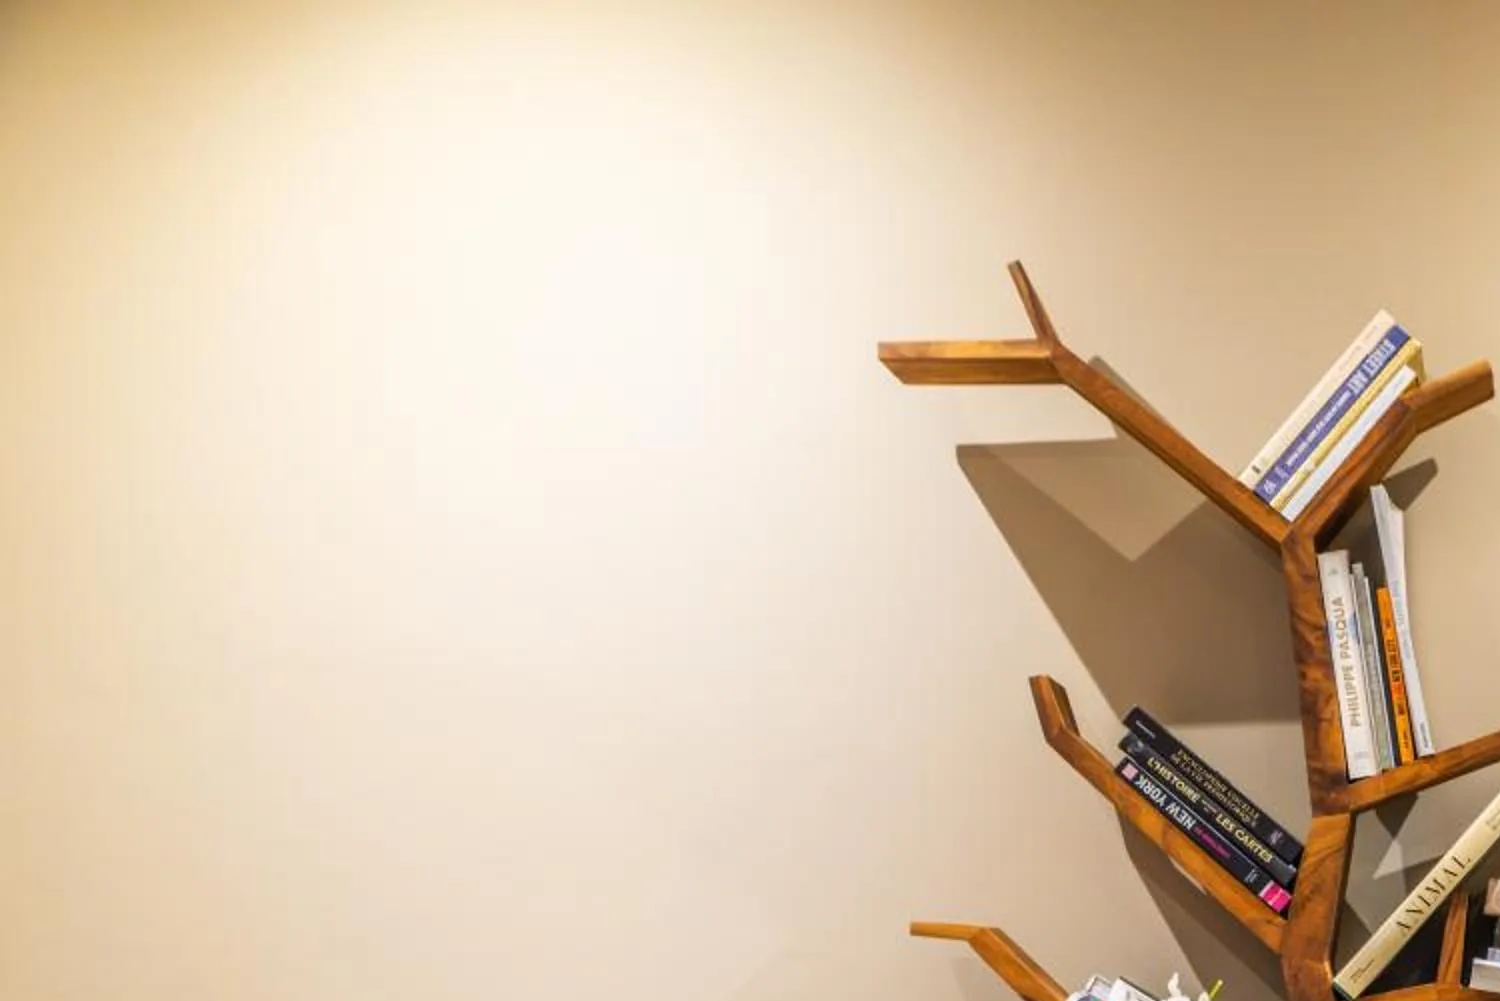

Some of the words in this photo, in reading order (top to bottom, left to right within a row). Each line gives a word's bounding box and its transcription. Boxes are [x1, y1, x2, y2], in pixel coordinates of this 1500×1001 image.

[1346, 367, 1369, 396] ART
[1362, 338, 1396, 378] STREET
[1334, 596, 1352, 659] PASQUA
[1341, 664, 1363, 728] PHILIPPE
[1135, 774, 1167, 806] YORK
[1147, 756, 1201, 804] L'HISTOIRE
[1165, 801, 1197, 831] NEW
[1215, 813, 1236, 834] LES
[1234, 828, 1274, 863] CARTES
[1394, 851, 1472, 933] ANIMAL
